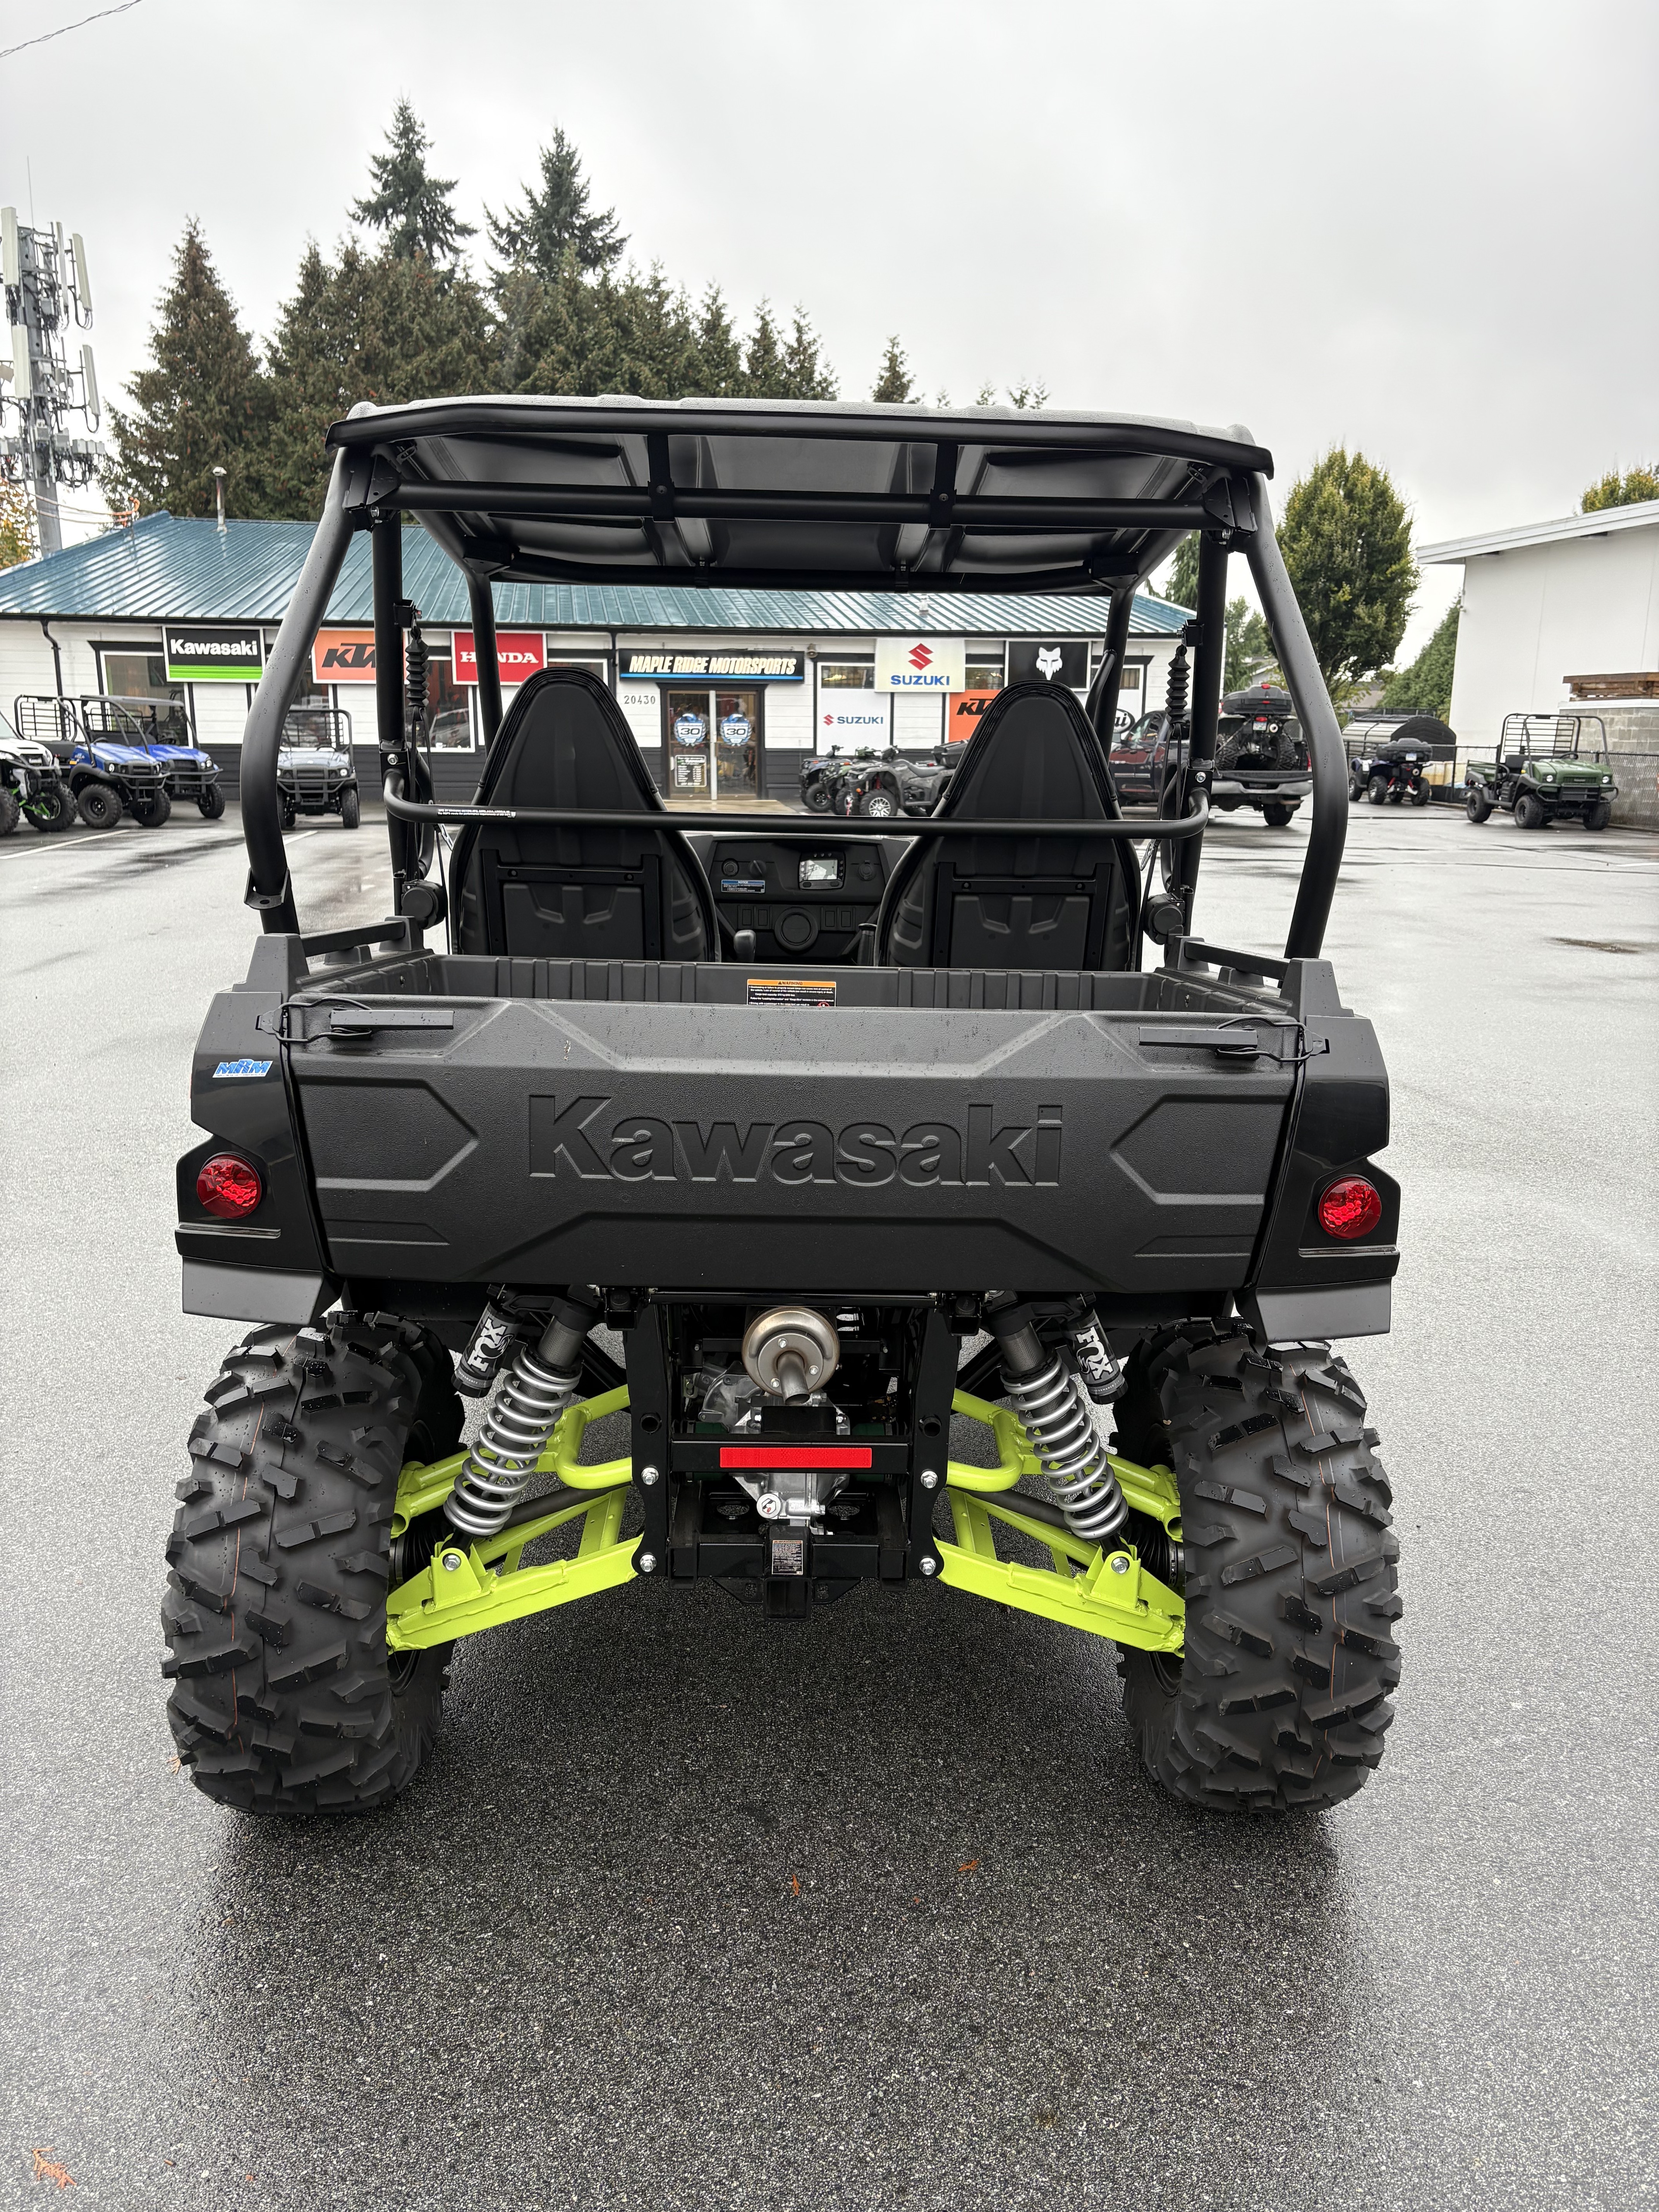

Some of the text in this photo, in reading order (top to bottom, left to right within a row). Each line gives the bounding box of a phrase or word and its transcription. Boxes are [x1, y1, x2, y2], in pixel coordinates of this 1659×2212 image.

[170, 639, 258, 656] Kawasaki
[460, 651, 539, 663] HNDA
[629, 656, 797, 675] MAPLE RIDGE MOTORSPORTS
[891, 675, 950, 685] SUZUKI
[624, 695, 656, 704] 20430
[957, 698, 993, 715] KT
[216, 1060, 271, 1074] MRM
[529, 1094, 1063, 1187] Kawasaki
[467, 1318, 514, 1371] FOX
[1076, 1326, 1113, 1379] FOX
